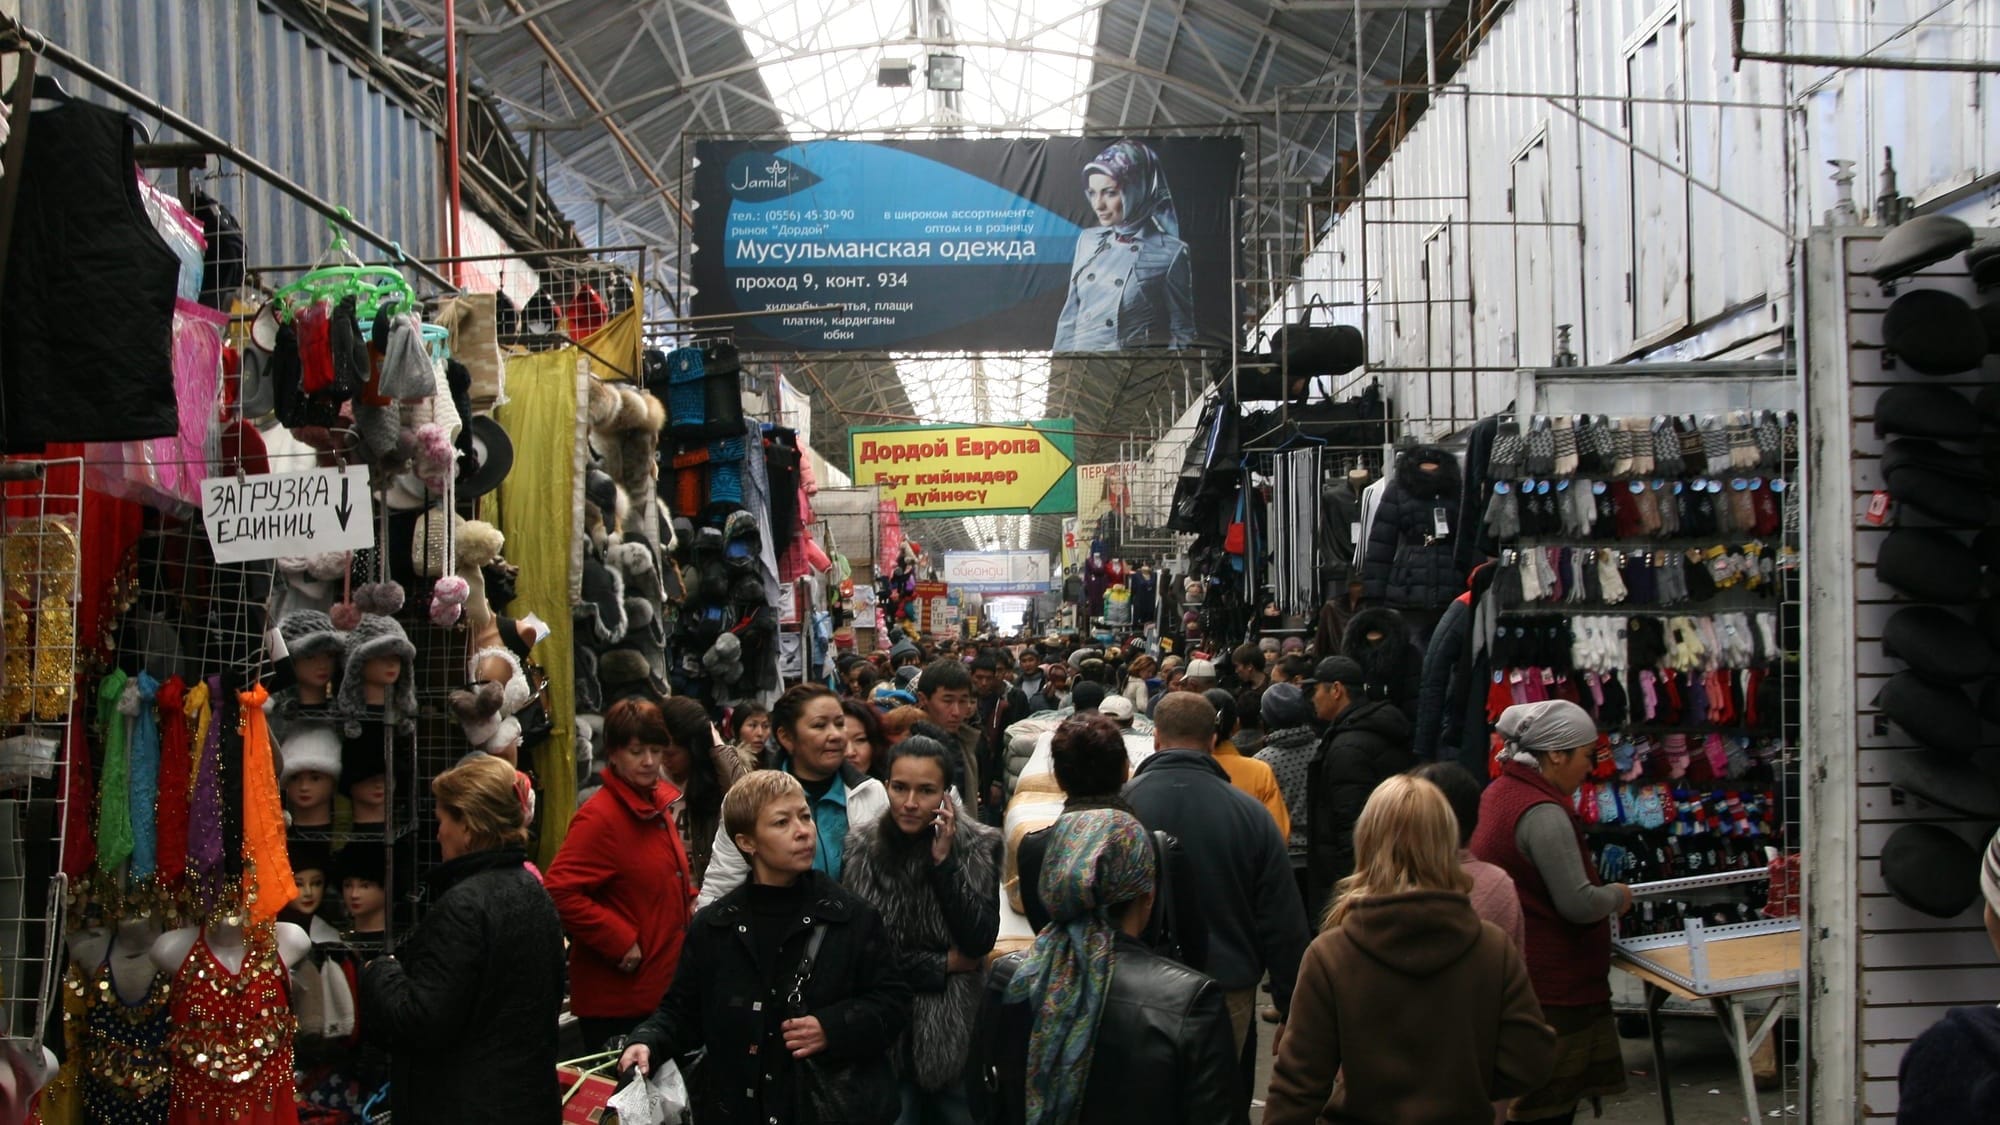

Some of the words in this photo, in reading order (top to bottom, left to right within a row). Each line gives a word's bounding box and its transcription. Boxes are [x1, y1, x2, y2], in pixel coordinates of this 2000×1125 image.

[731, 165, 787, 190] Jamila
[732, 211, 760, 221] тел.:
[765, 210, 801, 222] (0556)
[804, 209, 855, 221] 45-30-90
[884, 211, 891, 219] в
[894, 209, 948, 221] широком
[951, 208, 1034, 221] ассортименте
[731, 225, 768, 237] рынок
[925, 224, 961, 234] оптом
[964, 224, 972, 233] и
[975, 224, 983, 233] в
[986, 223, 1034, 235] розницу
[736, 239, 931, 264] Мусульманская
[939, 239, 1036, 261] одежда
[736, 276, 798, 292] проход
[802, 273, 819, 290] 9,
[826, 275, 871, 288] конт.
[877, 272, 908, 287] 934
[874, 302, 913, 312] плащи
[782, 316, 828, 327] платки,
[831, 316, 895, 327] кардиганы
[823, 329, 854, 340] юбки
[859, 437, 949, 464] Дордой
[955, 436, 1041, 460] Европа
[874, 471, 910, 490] Бут
[208, 475, 329, 517] ЗАГРУЗКА
[904, 488, 988, 506] дүйнөсү
[217, 511, 315, 544] ЕДИНИЦ
